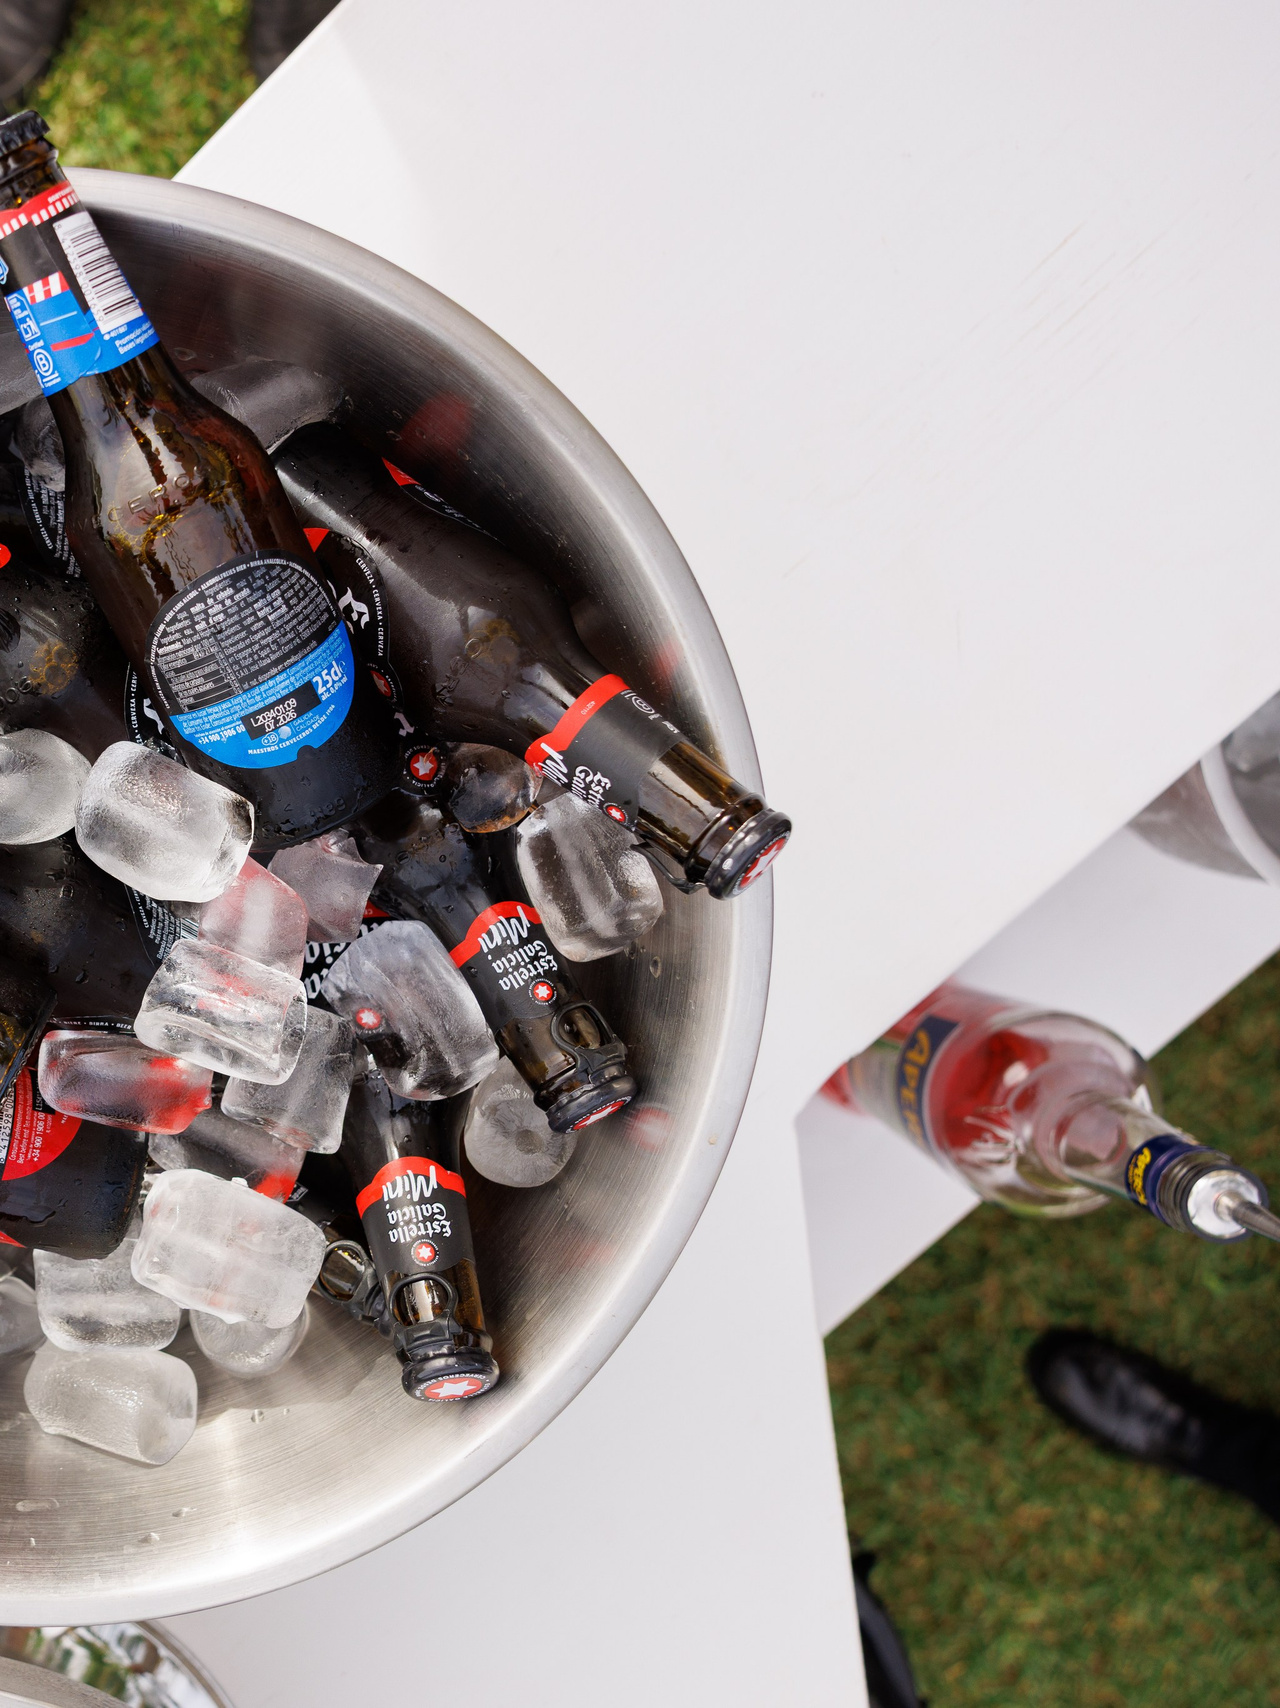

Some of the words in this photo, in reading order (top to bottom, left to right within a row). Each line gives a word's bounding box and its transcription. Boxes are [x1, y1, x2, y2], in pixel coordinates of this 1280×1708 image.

[79, 281, 106, 322] 001659
[117, 339, 135, 354] Bases
[30, 502, 41, 523] CERVEJA
[39, 526, 54, 549] CERVEZA
[355, 558, 374, 584] CERVEZA
[372, 589, 382, 619] CERVEXA
[173, 601, 184, 612] SANS
[183, 589, 198, 603] ALCOOL
[189, 601, 205, 613] malta
[207, 603, 222, 615] malte
[255, 605, 272, 619] barley
[193, 619, 206, 630] malt
[318, 688, 330, 701] alc.
[327, 679, 342, 693] 0,0%
[129, 698, 137, 728] CERVEXA
[291, 710, 312, 725] GALICIA
[294, 713, 320, 731] CALIDADE
[198, 736, 208, 744] +34
[208, 732, 220, 742] 900
[234, 723, 245, 733] 00
[247, 744, 278, 753] MAESTROS
[279, 727, 313, 748] CERVECEROS
[310, 715, 327, 730] DESDE
[476, 906, 530, 957] Mini
[491, 940, 548, 973] Galicia
[498, 954, 555, 992] Estrella
[0, 1113, 11, 1149] 412598
[9, 1138, 17, 1160] Consumir
[13, 1104, 21, 1139] preferentemente
[35, 1120, 44, 1134] 1906
[33, 1136, 42, 1147] 900
[31, 1148, 40, 1162] +34
[382, 1165, 437, 1208] Mini
[386, 1202, 445, 1224] Galicia
[388, 1220, 451, 1242] Estrella
